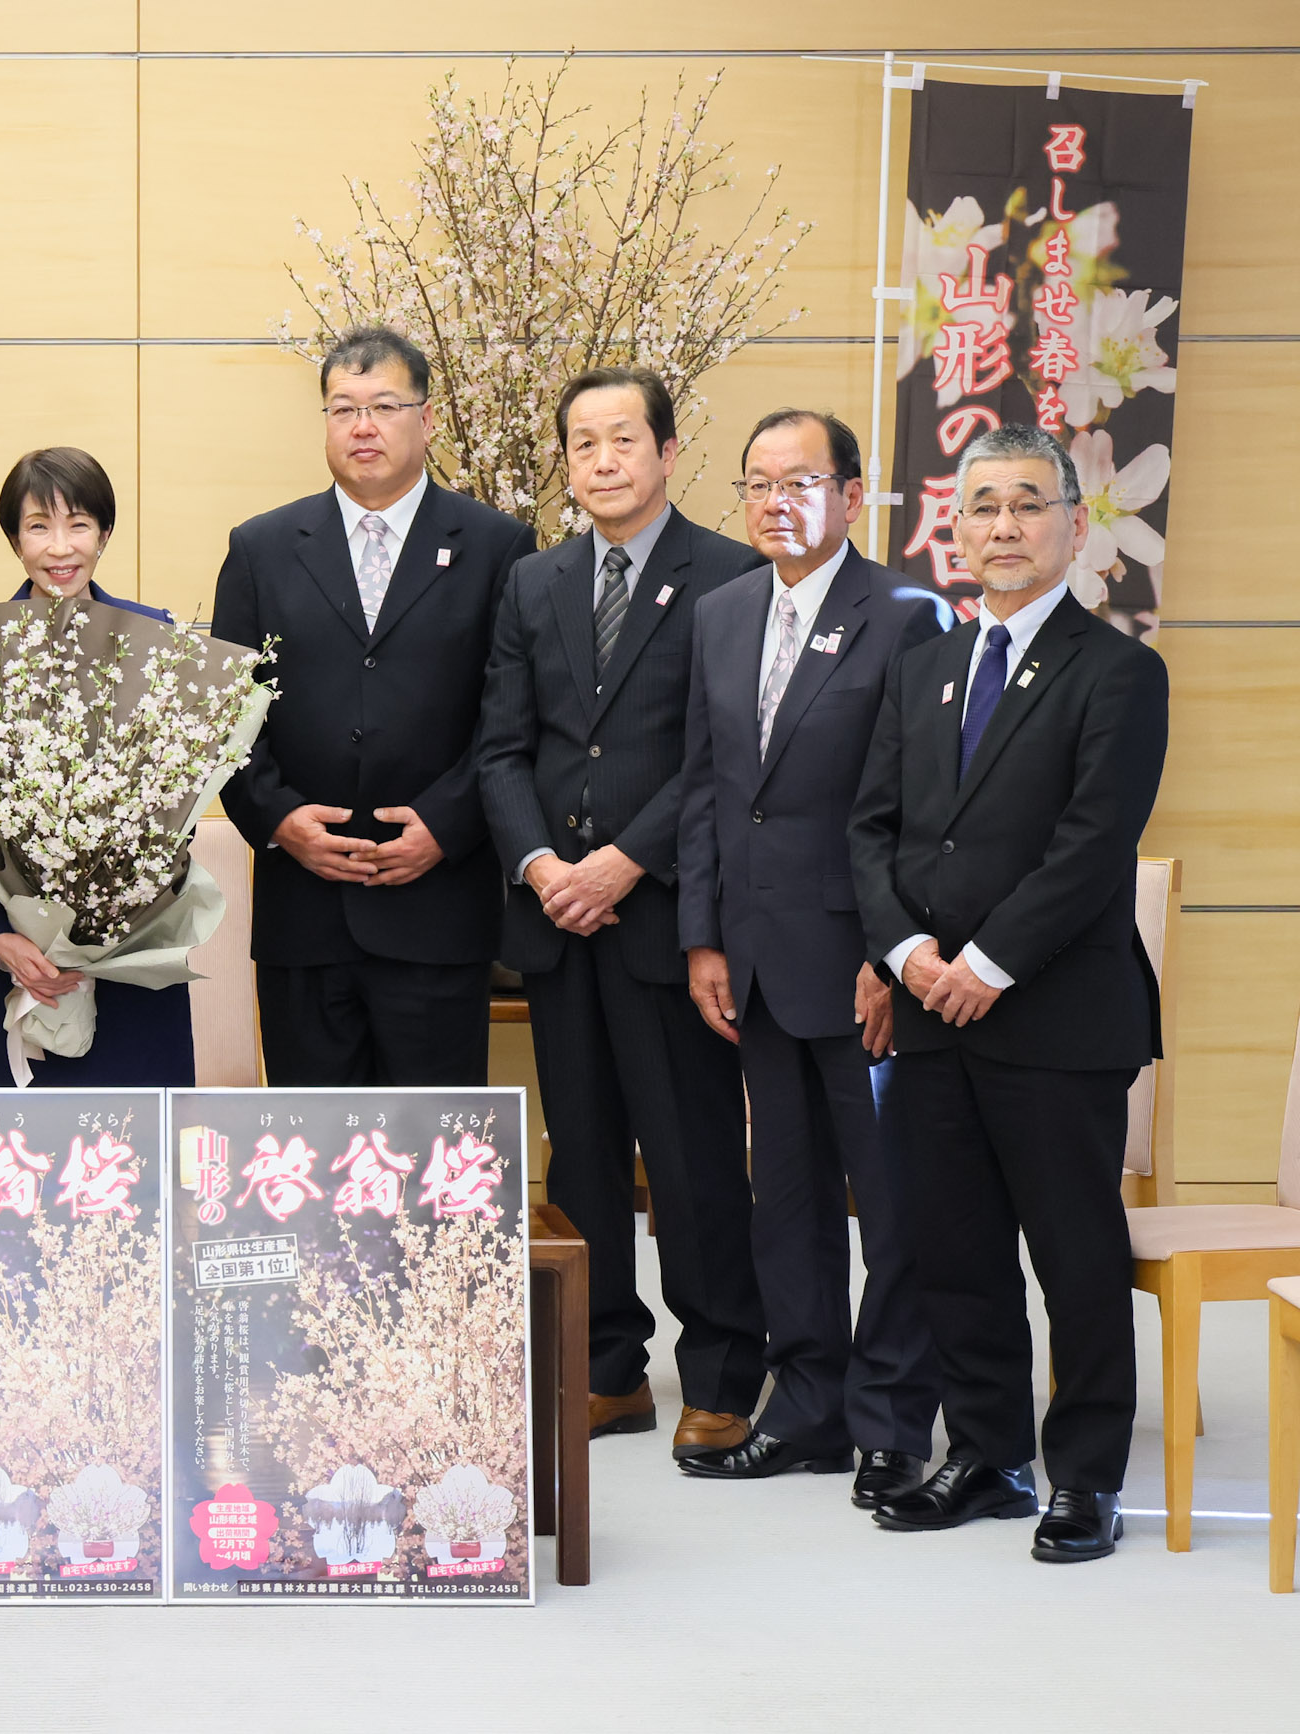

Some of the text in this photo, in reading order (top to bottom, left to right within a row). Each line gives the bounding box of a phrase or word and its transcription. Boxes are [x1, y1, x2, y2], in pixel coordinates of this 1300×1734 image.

[1030, 124, 1087, 434] 召しませ春を
[78, 1112, 119, 1127] ざくら
[260, 1112, 481, 1128] けい おう ざくら
[194, 1130, 230, 1226] 山形の
[235, 1128, 502, 1223] 啓翁桜
[202, 1239, 288, 1259] 山形県は生産量
[209, 1514, 257, 1525] 山形県全域
[212, 1539, 255, 1550] 12月下旬
[62, 1561, 131, 1576] 自宅でも飾れます
[330, 1562, 376, 1576] 産地の様子
[429, 1561, 498, 1576] 自宅でも飾れます
[42, 1583, 151, 1593] TEL:023-630-2458
[410, 1584, 519, 1594] TEL:023-630-2458
